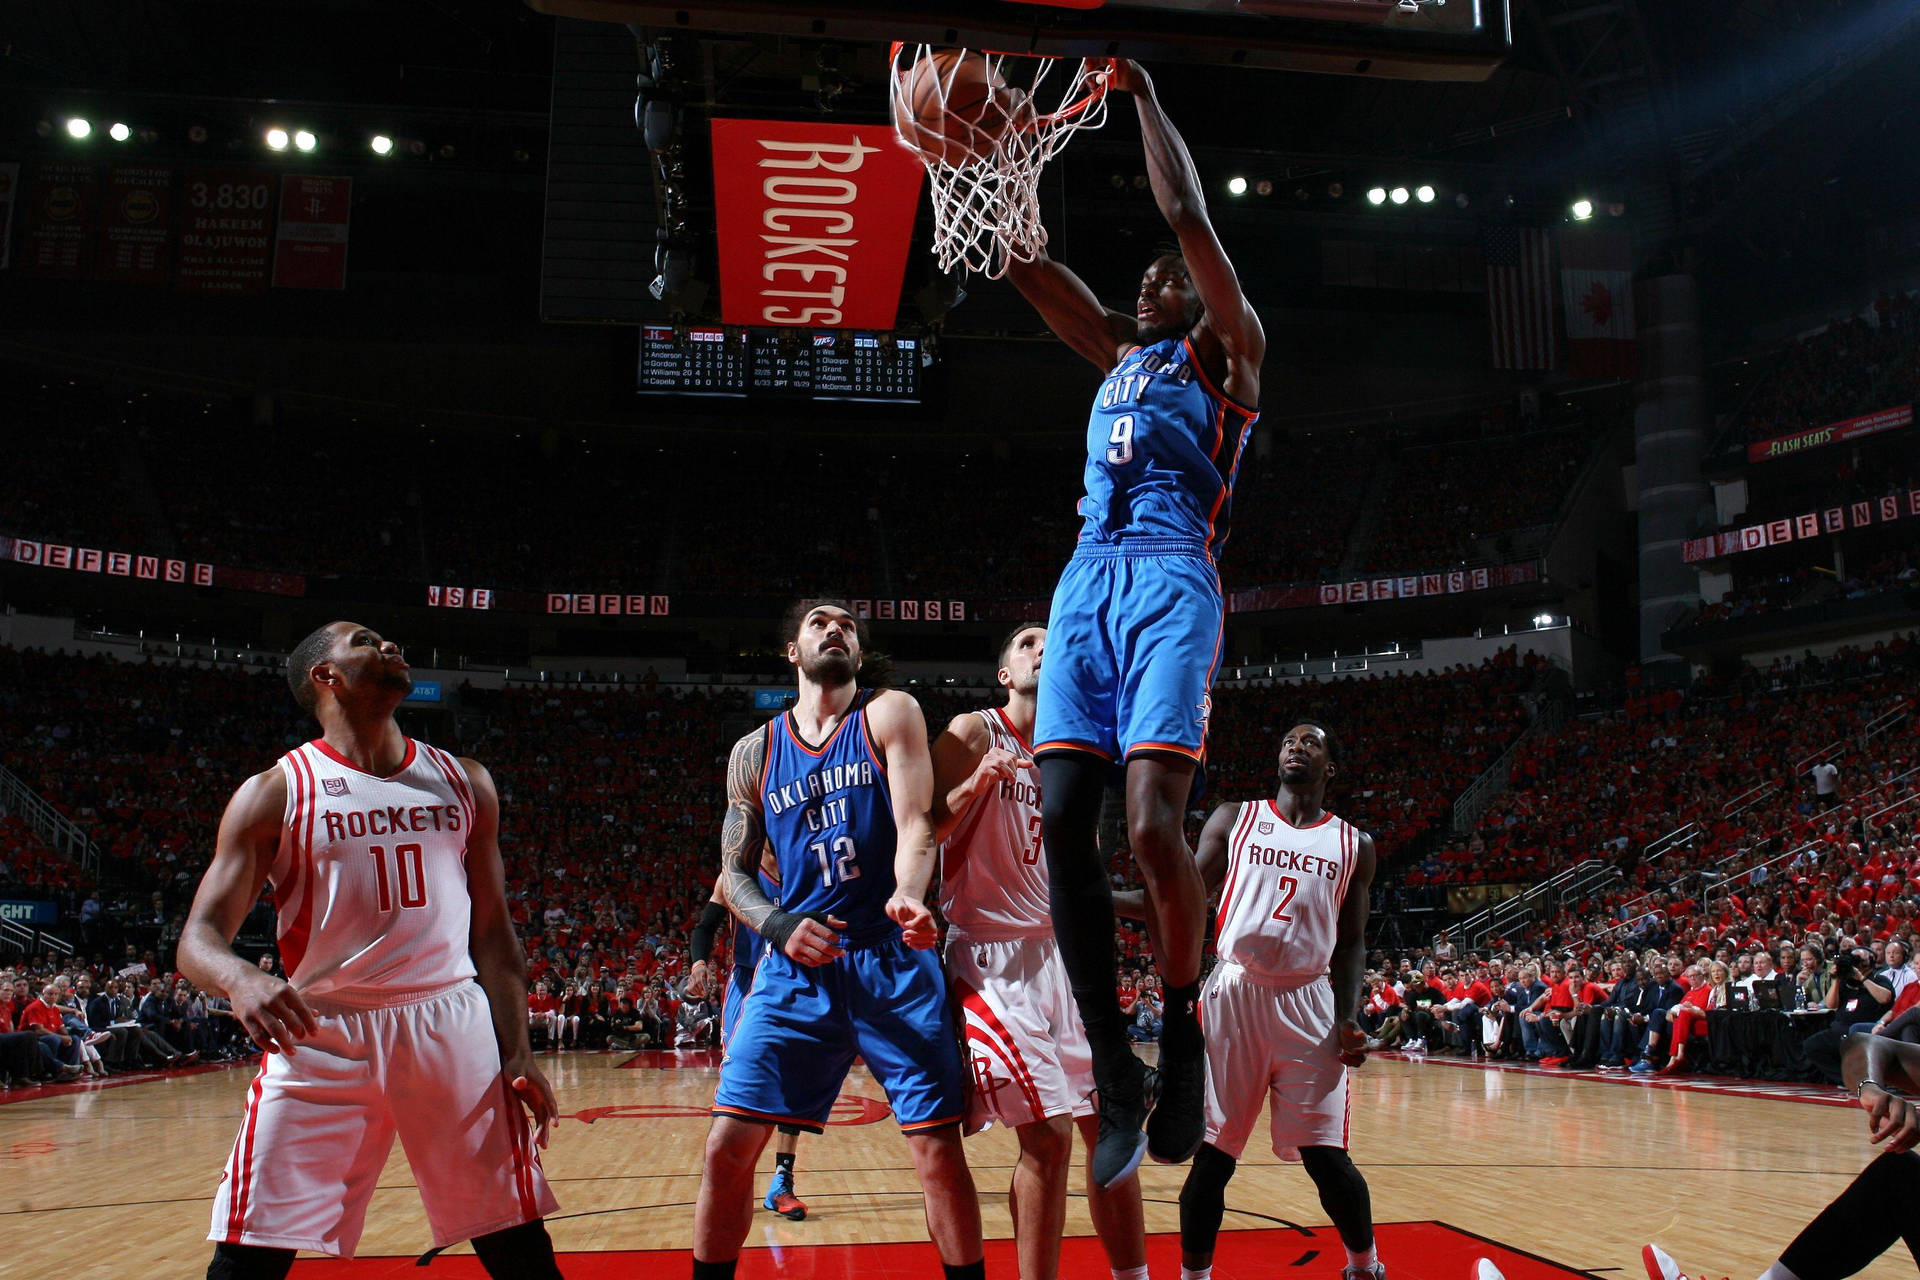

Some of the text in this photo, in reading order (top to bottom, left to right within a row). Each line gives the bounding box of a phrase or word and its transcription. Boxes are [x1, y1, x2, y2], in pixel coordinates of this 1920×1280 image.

[191, 182, 269, 212] 3,830
[195, 216, 264, 230] HAKEEM
[757, 133, 884, 325] ROCKETS
[183, 233, 267, 249] OLAJUWON
[1102, 374, 1154, 409] CITY
[1107, 413, 1135, 466] 9
[1766, 440, 1801, 456] FLASH
[1802, 426, 1839, 448] SEATS
[1746, 491, 1920, 548] DEFENSE
[19, 542, 212, 584] DEFENSE
[1322, 569, 1488, 603] DEFENSE
[551, 595, 667, 613] DEFEN
[855, 601, 963, 619] FENSE
[413, 687, 435, 696] AT&T
[326, 779, 340, 789] 50
[767, 761, 873, 815] OKLAHOMA
[1000, 778, 1042, 810] ROCK
[320, 805, 461, 842] ROCKETS
[805, 797, 848, 832] CITY
[1022, 815, 1042, 866] 3
[369, 843, 427, 913] 10
[810, 835, 861, 888] 12
[1248, 843, 1339, 881] ROCKETS
[1272, 875, 1299, 923] 2
